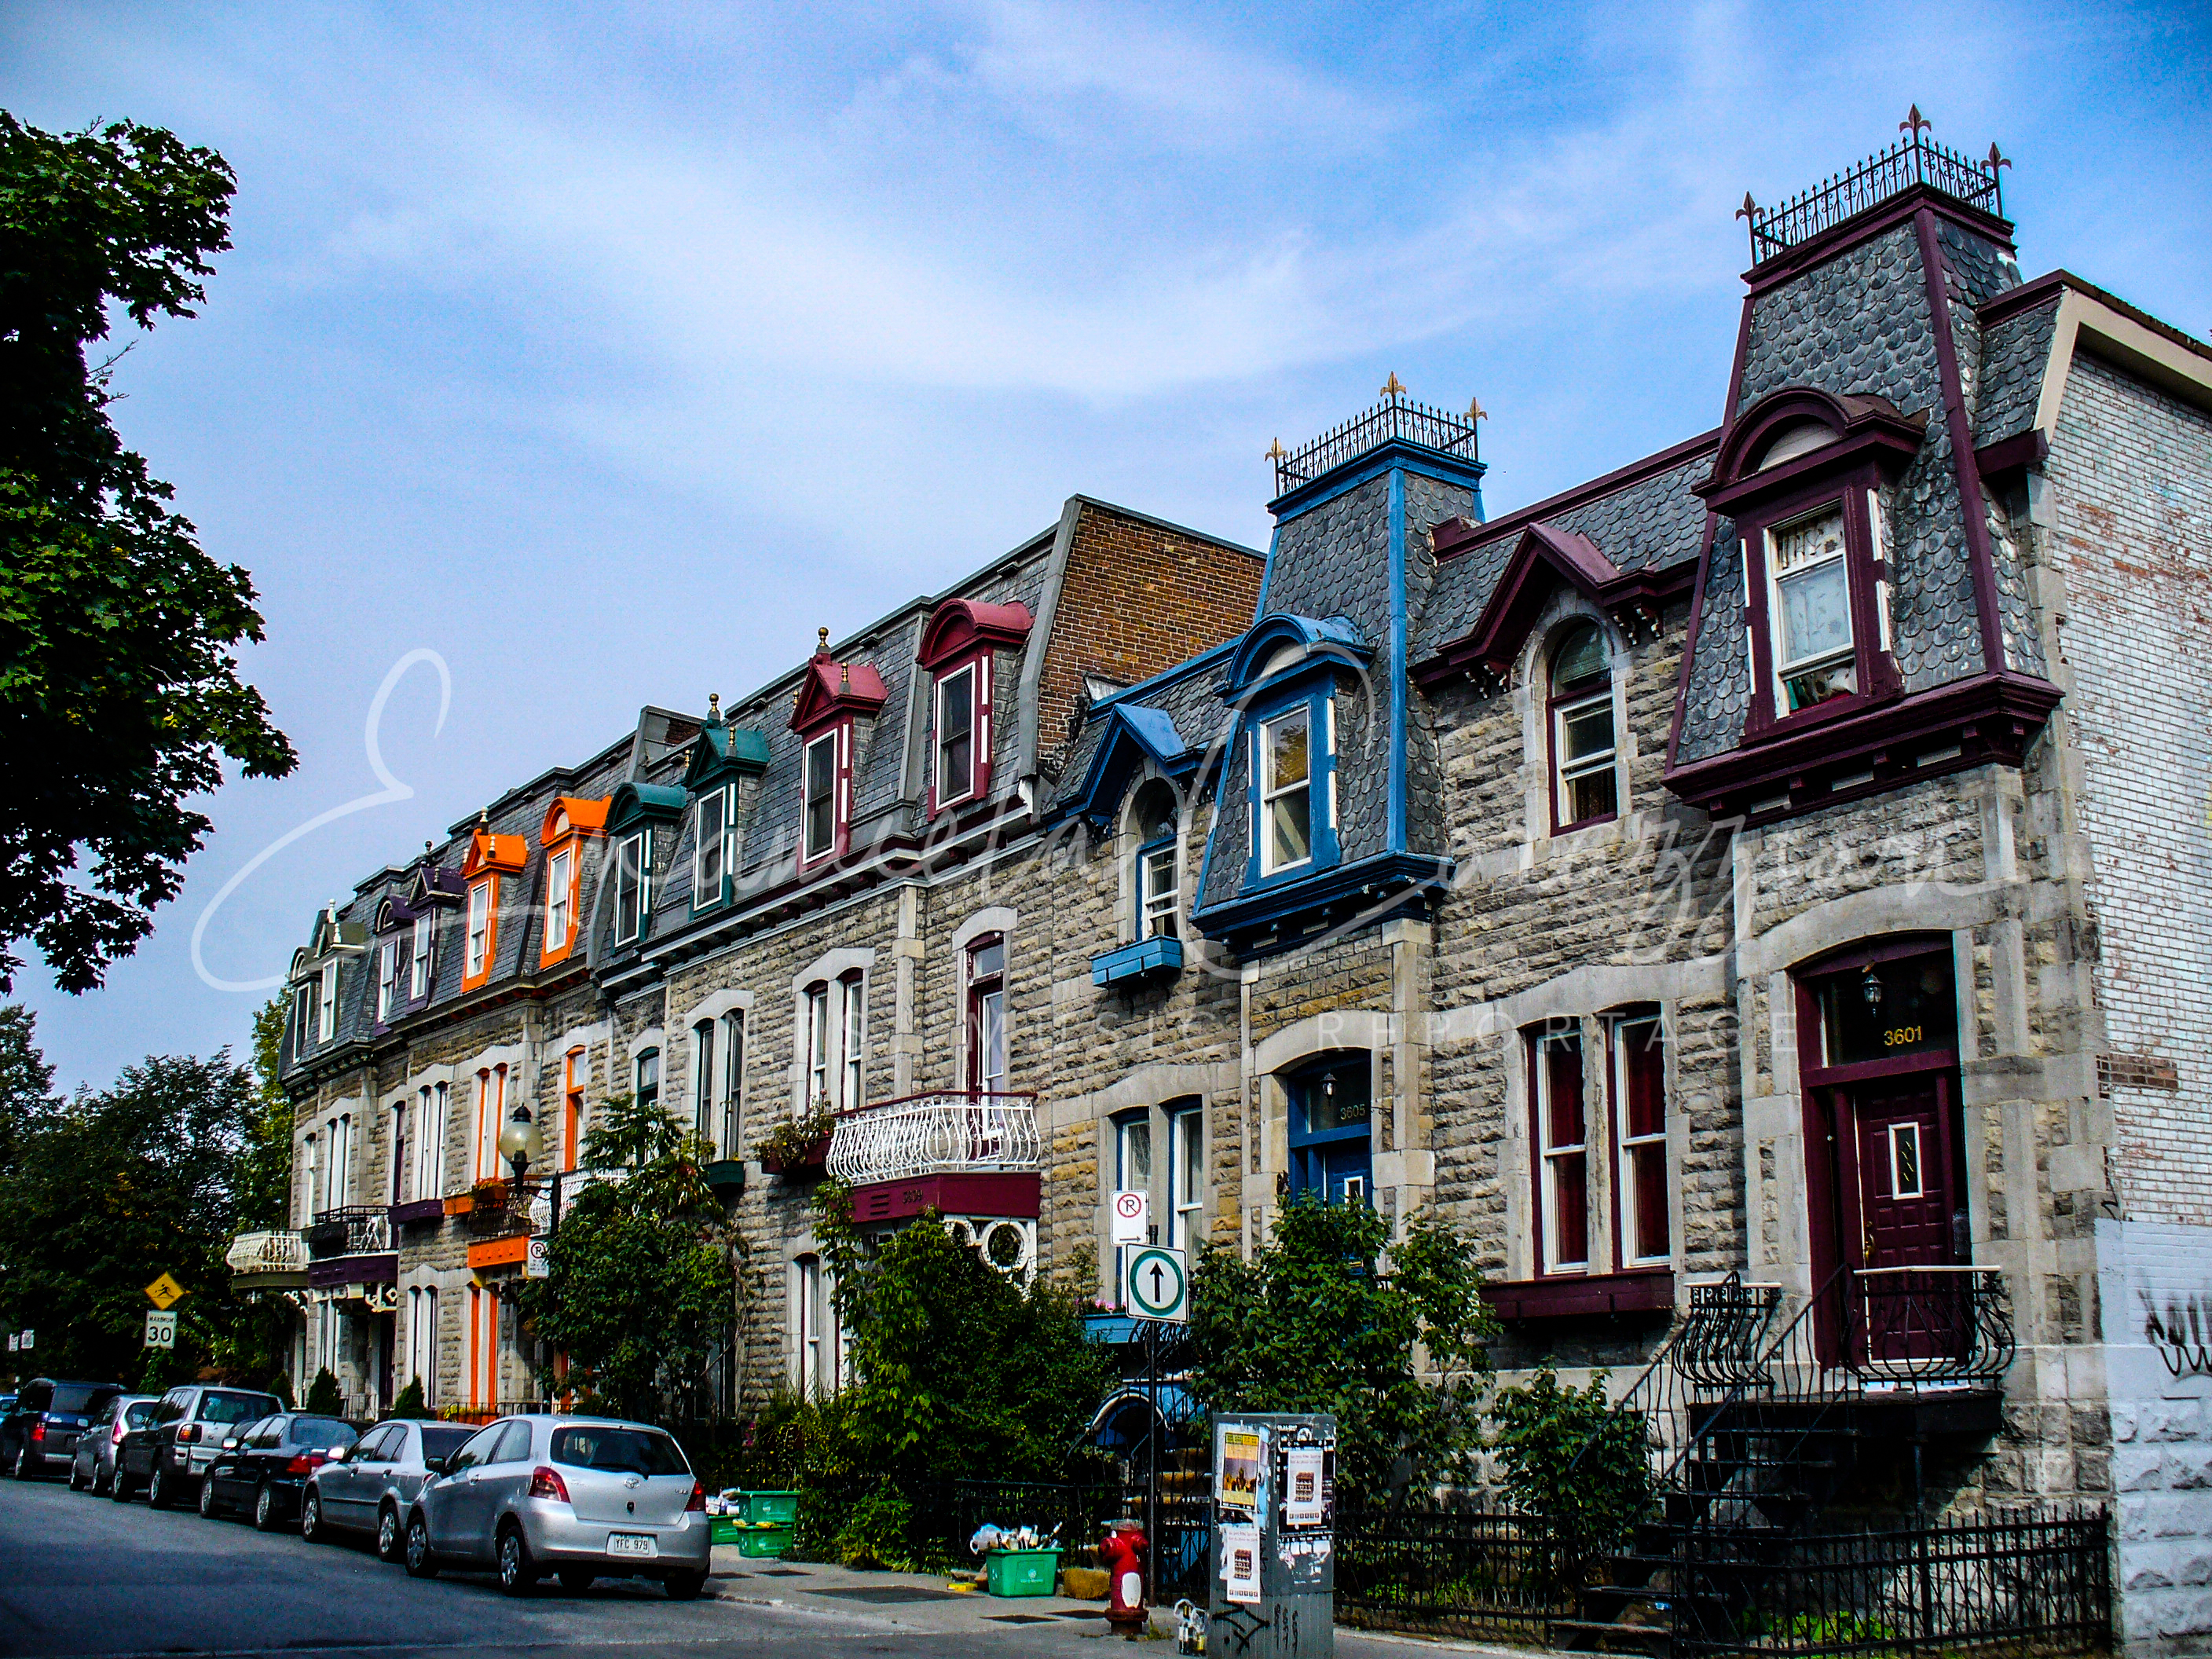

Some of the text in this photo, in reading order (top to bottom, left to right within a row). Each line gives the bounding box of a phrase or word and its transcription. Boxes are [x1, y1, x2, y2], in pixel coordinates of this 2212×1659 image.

[1884, 1025, 1922, 1046] 3601
[1340, 1104, 1365, 1120] 3605
[148, 1326, 172, 1342] 30
